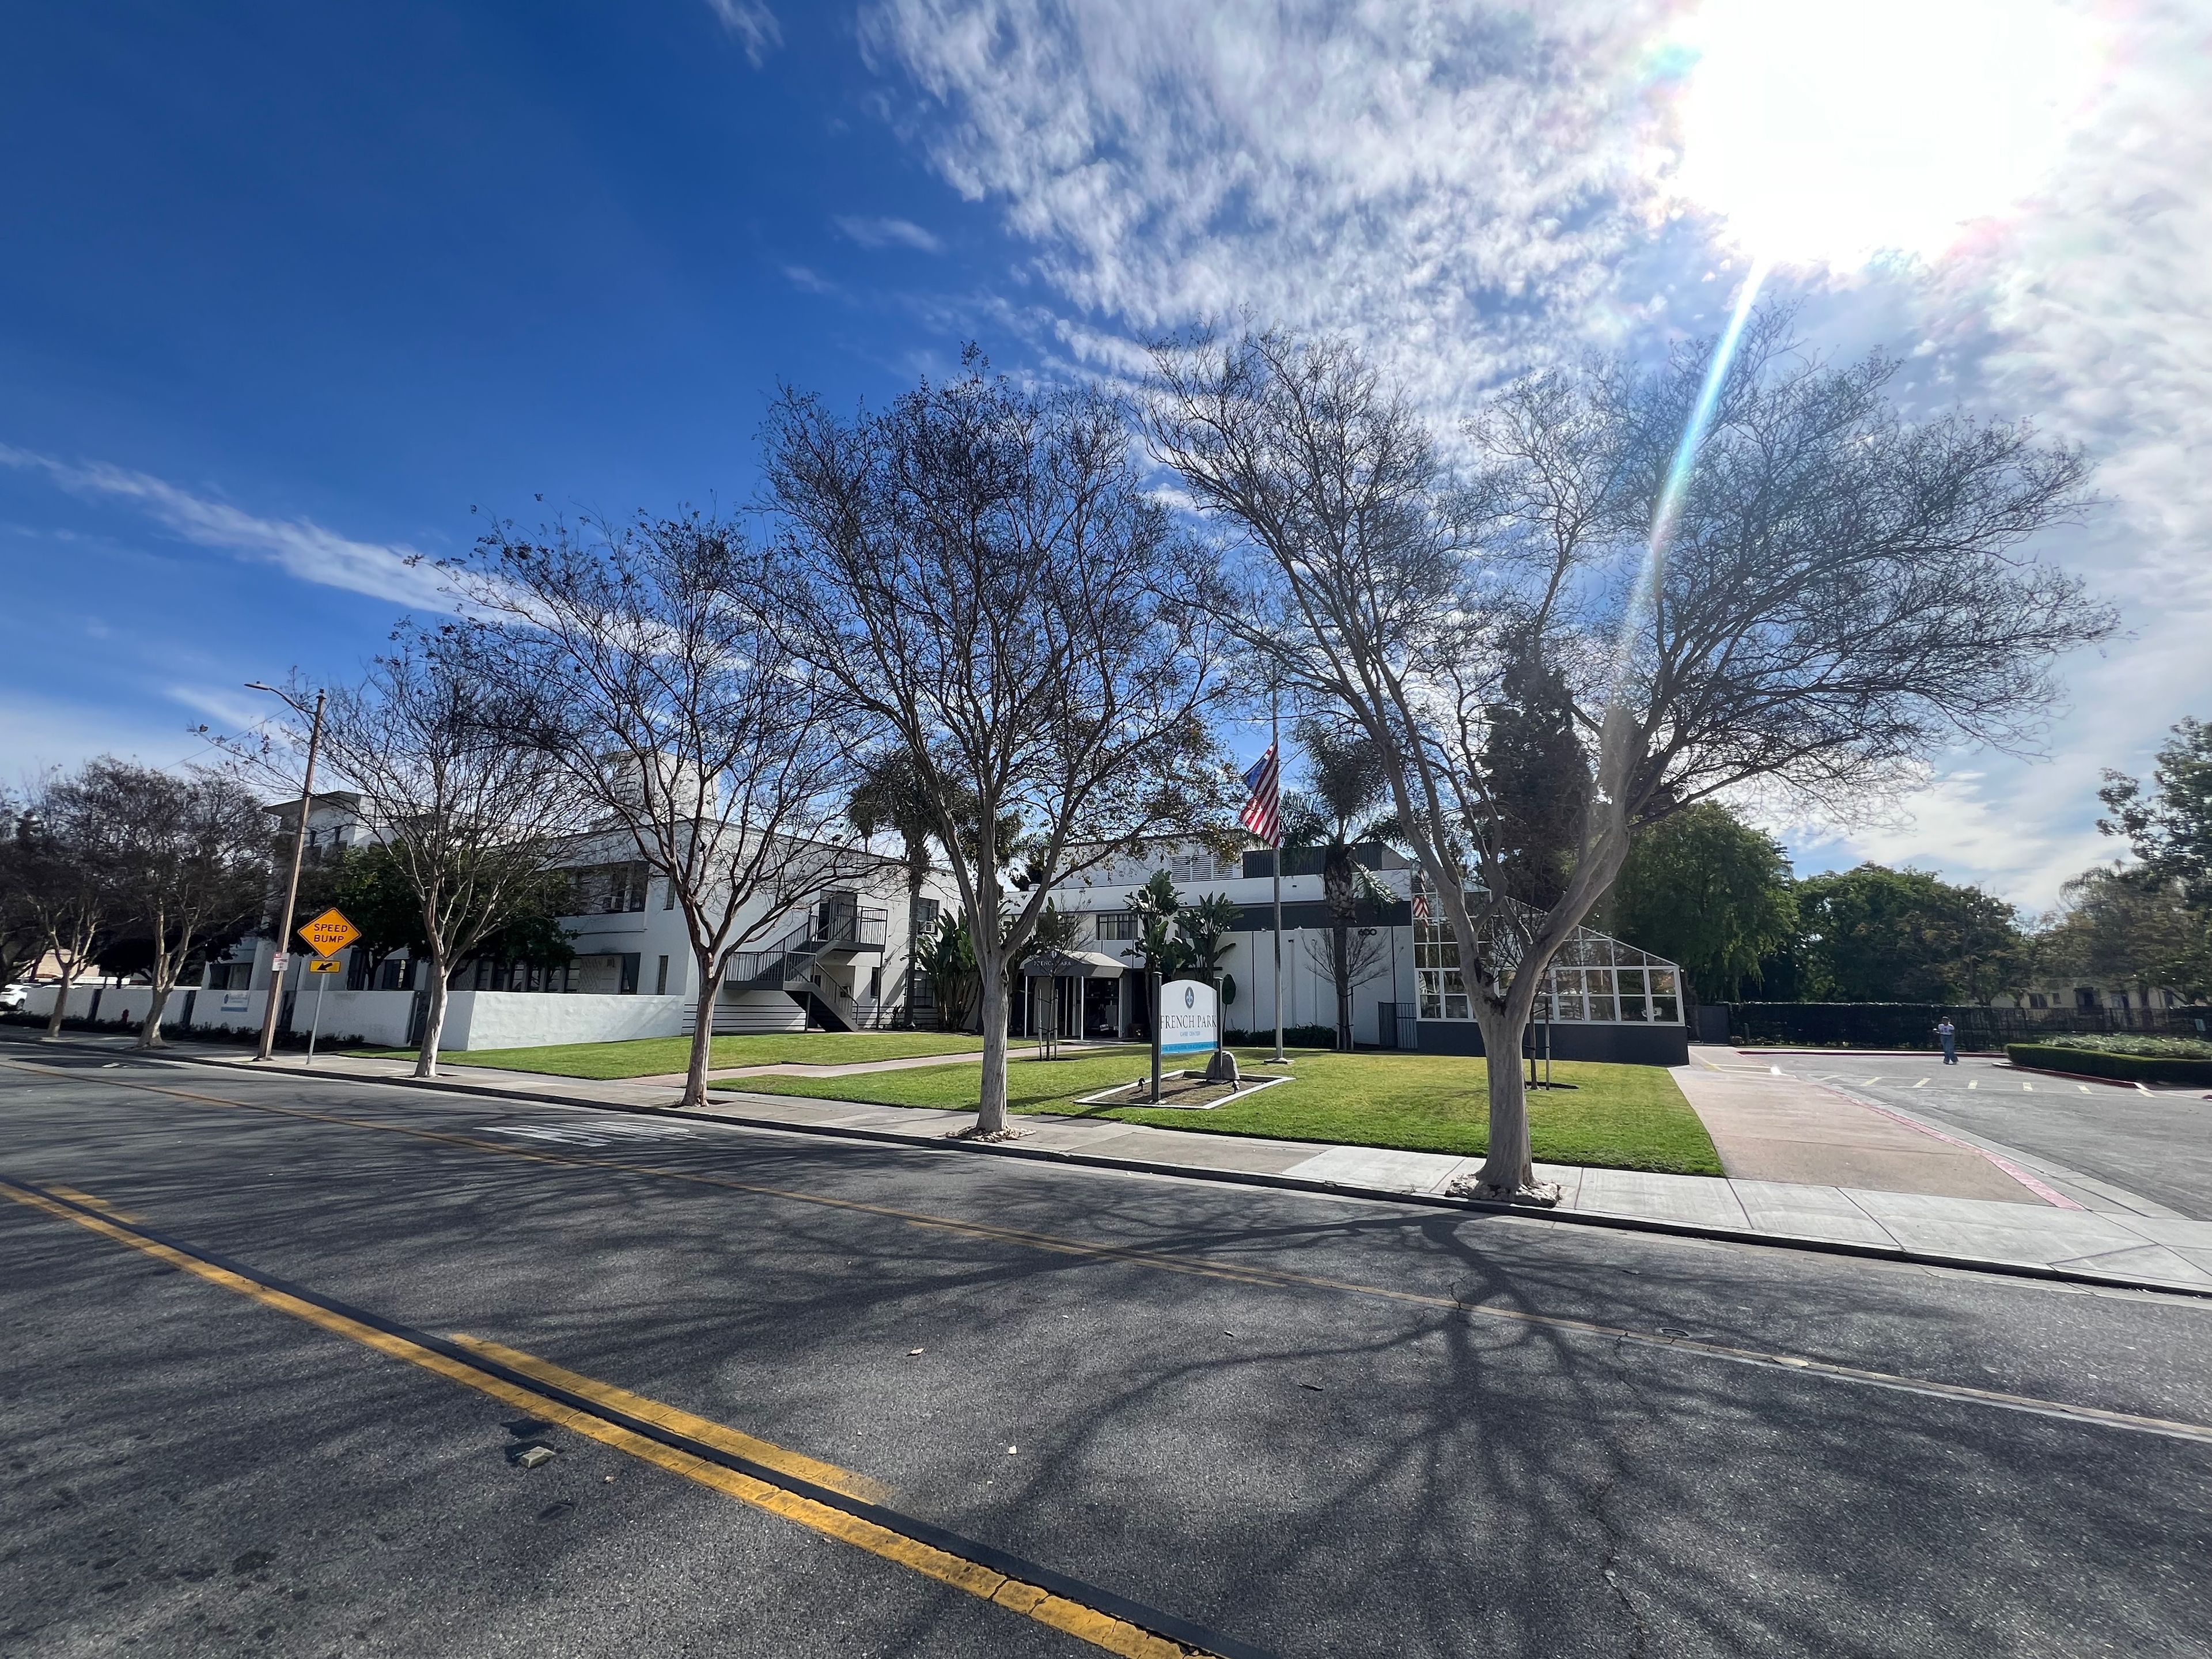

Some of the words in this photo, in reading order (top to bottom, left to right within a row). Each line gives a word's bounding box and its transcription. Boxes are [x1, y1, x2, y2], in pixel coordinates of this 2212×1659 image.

[314, 923, 348, 933] SPEED
[314, 934, 344, 943] BUMP
[1161, 1015, 1194, 1029] FRENCH
[1197, 1014, 1217, 1028] PARK
